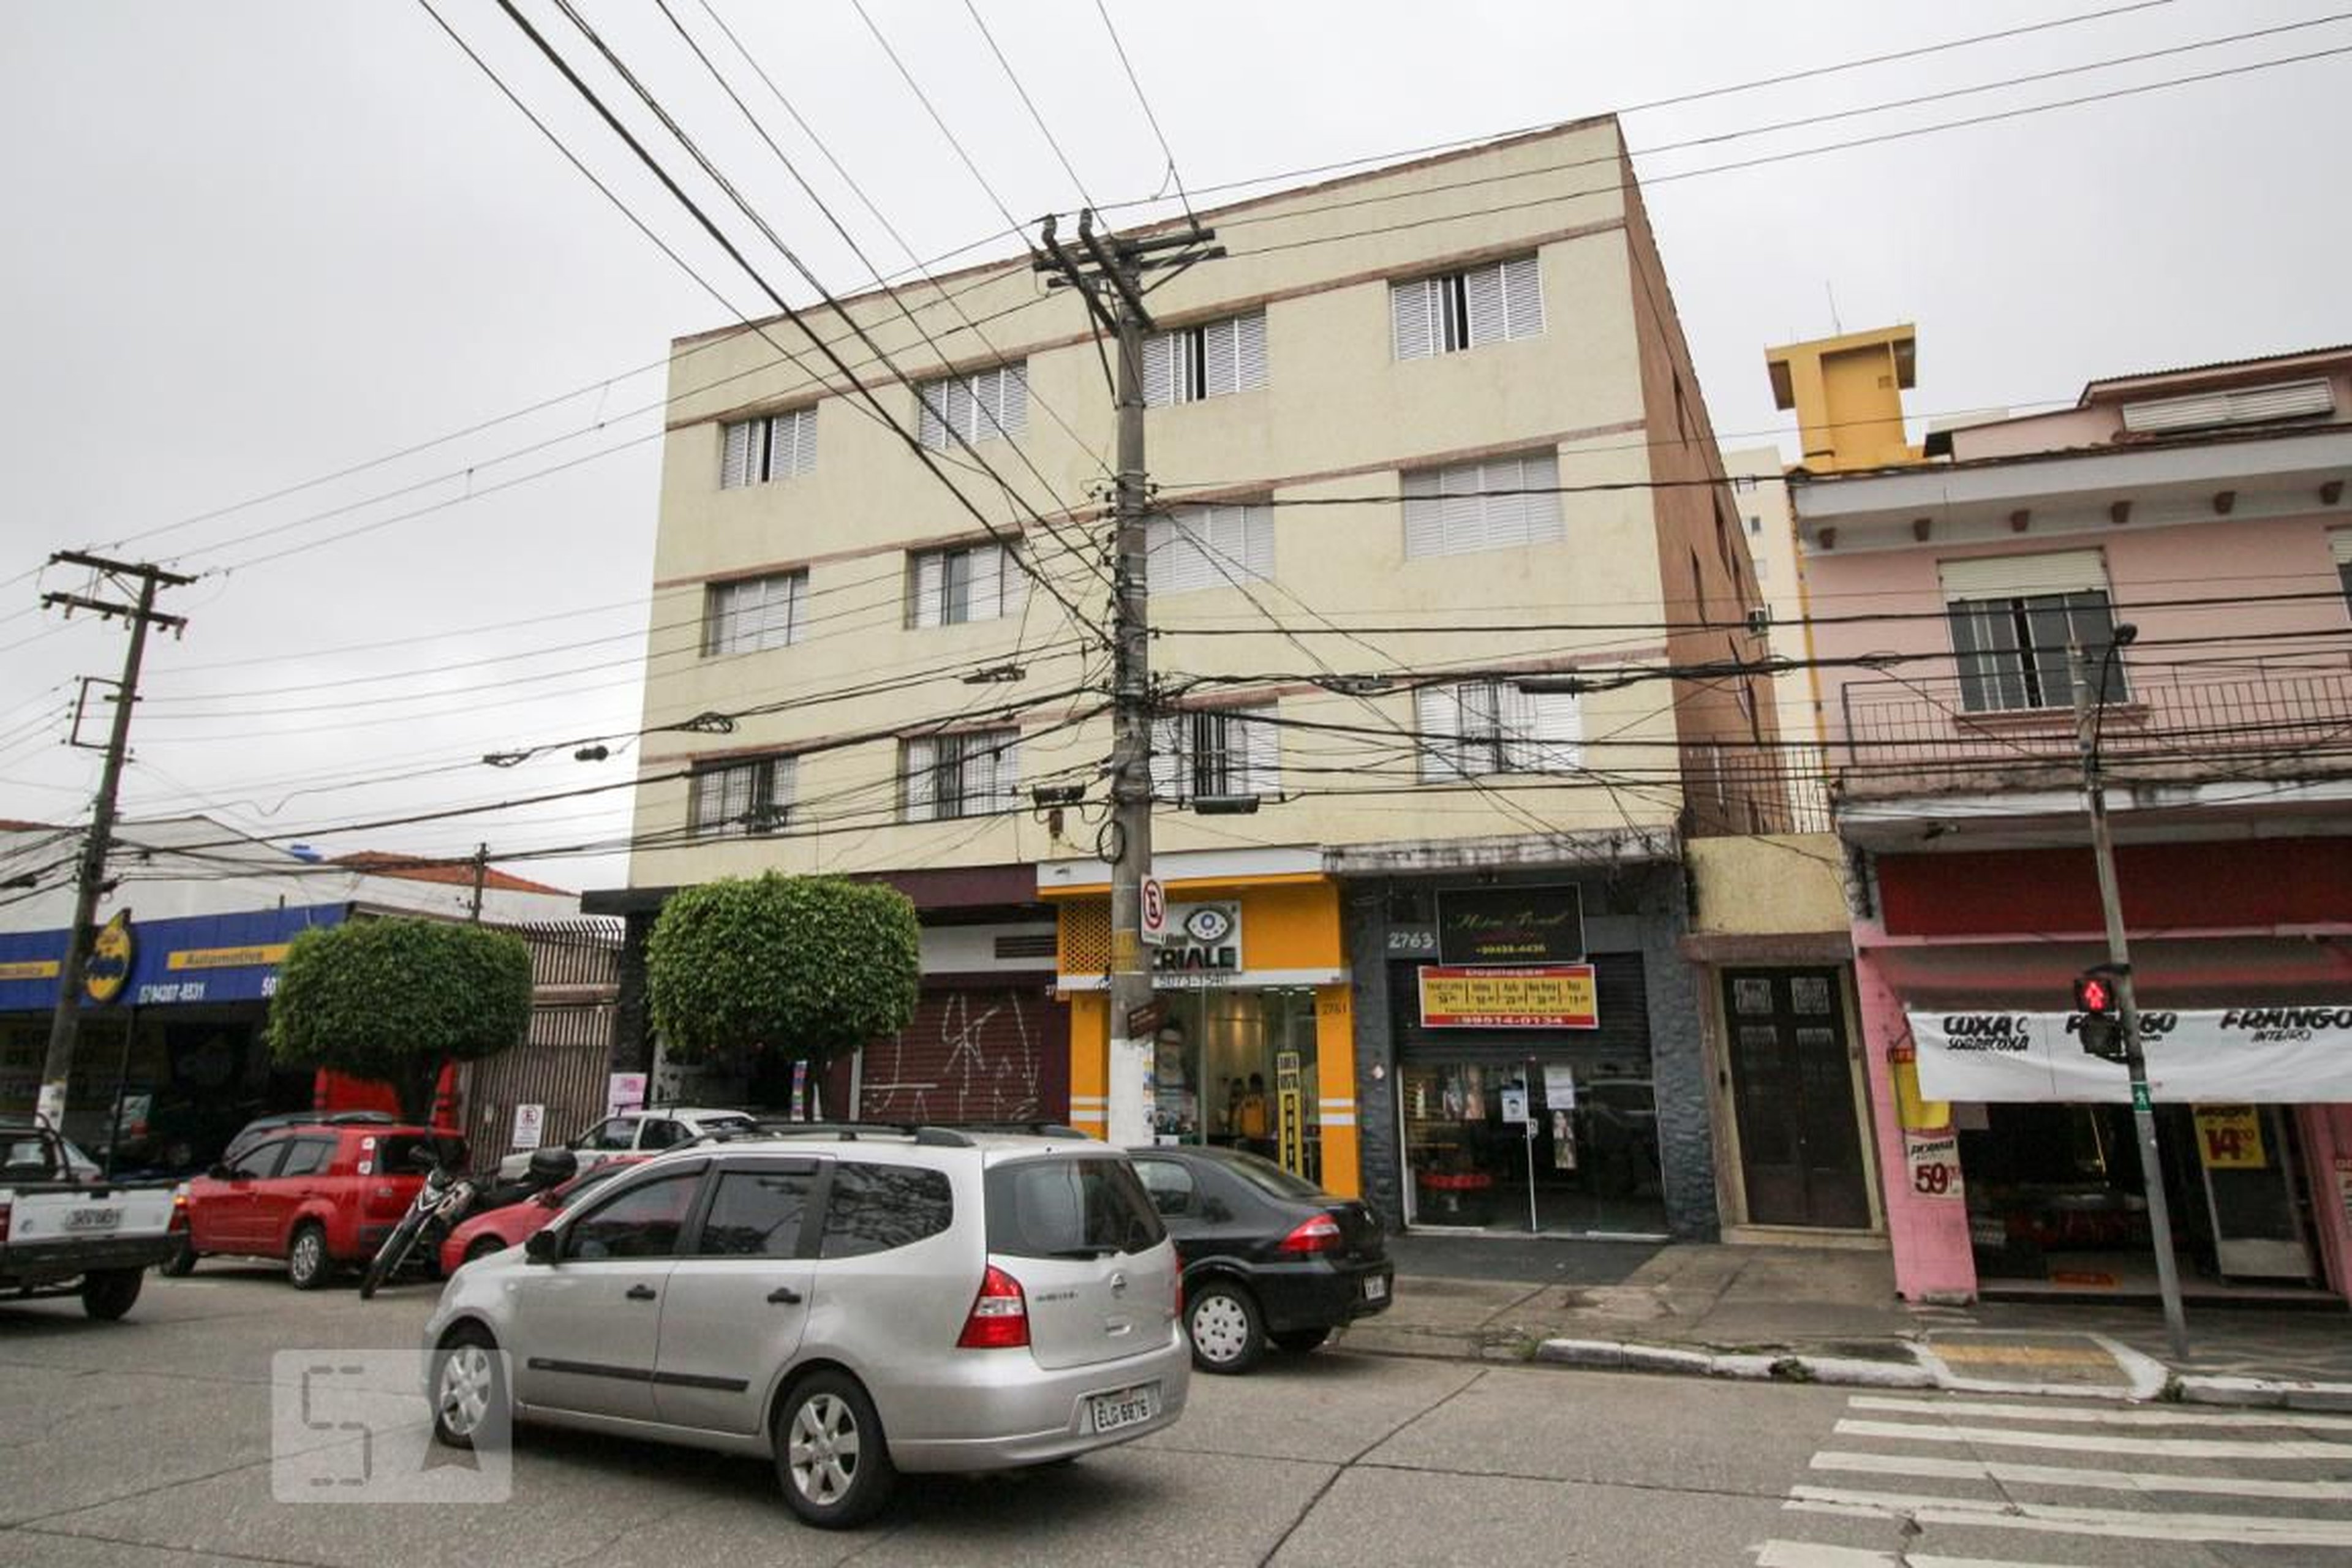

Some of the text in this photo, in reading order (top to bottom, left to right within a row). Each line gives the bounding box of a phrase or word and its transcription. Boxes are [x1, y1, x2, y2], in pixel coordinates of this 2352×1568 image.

[1388, 931, 1434, 949] 2763
[1943, 1016, 2011, 1036] COXA
[2220, 1009, 2352, 1030] FRANGO
[1915, 1162, 1948, 1194] 59
